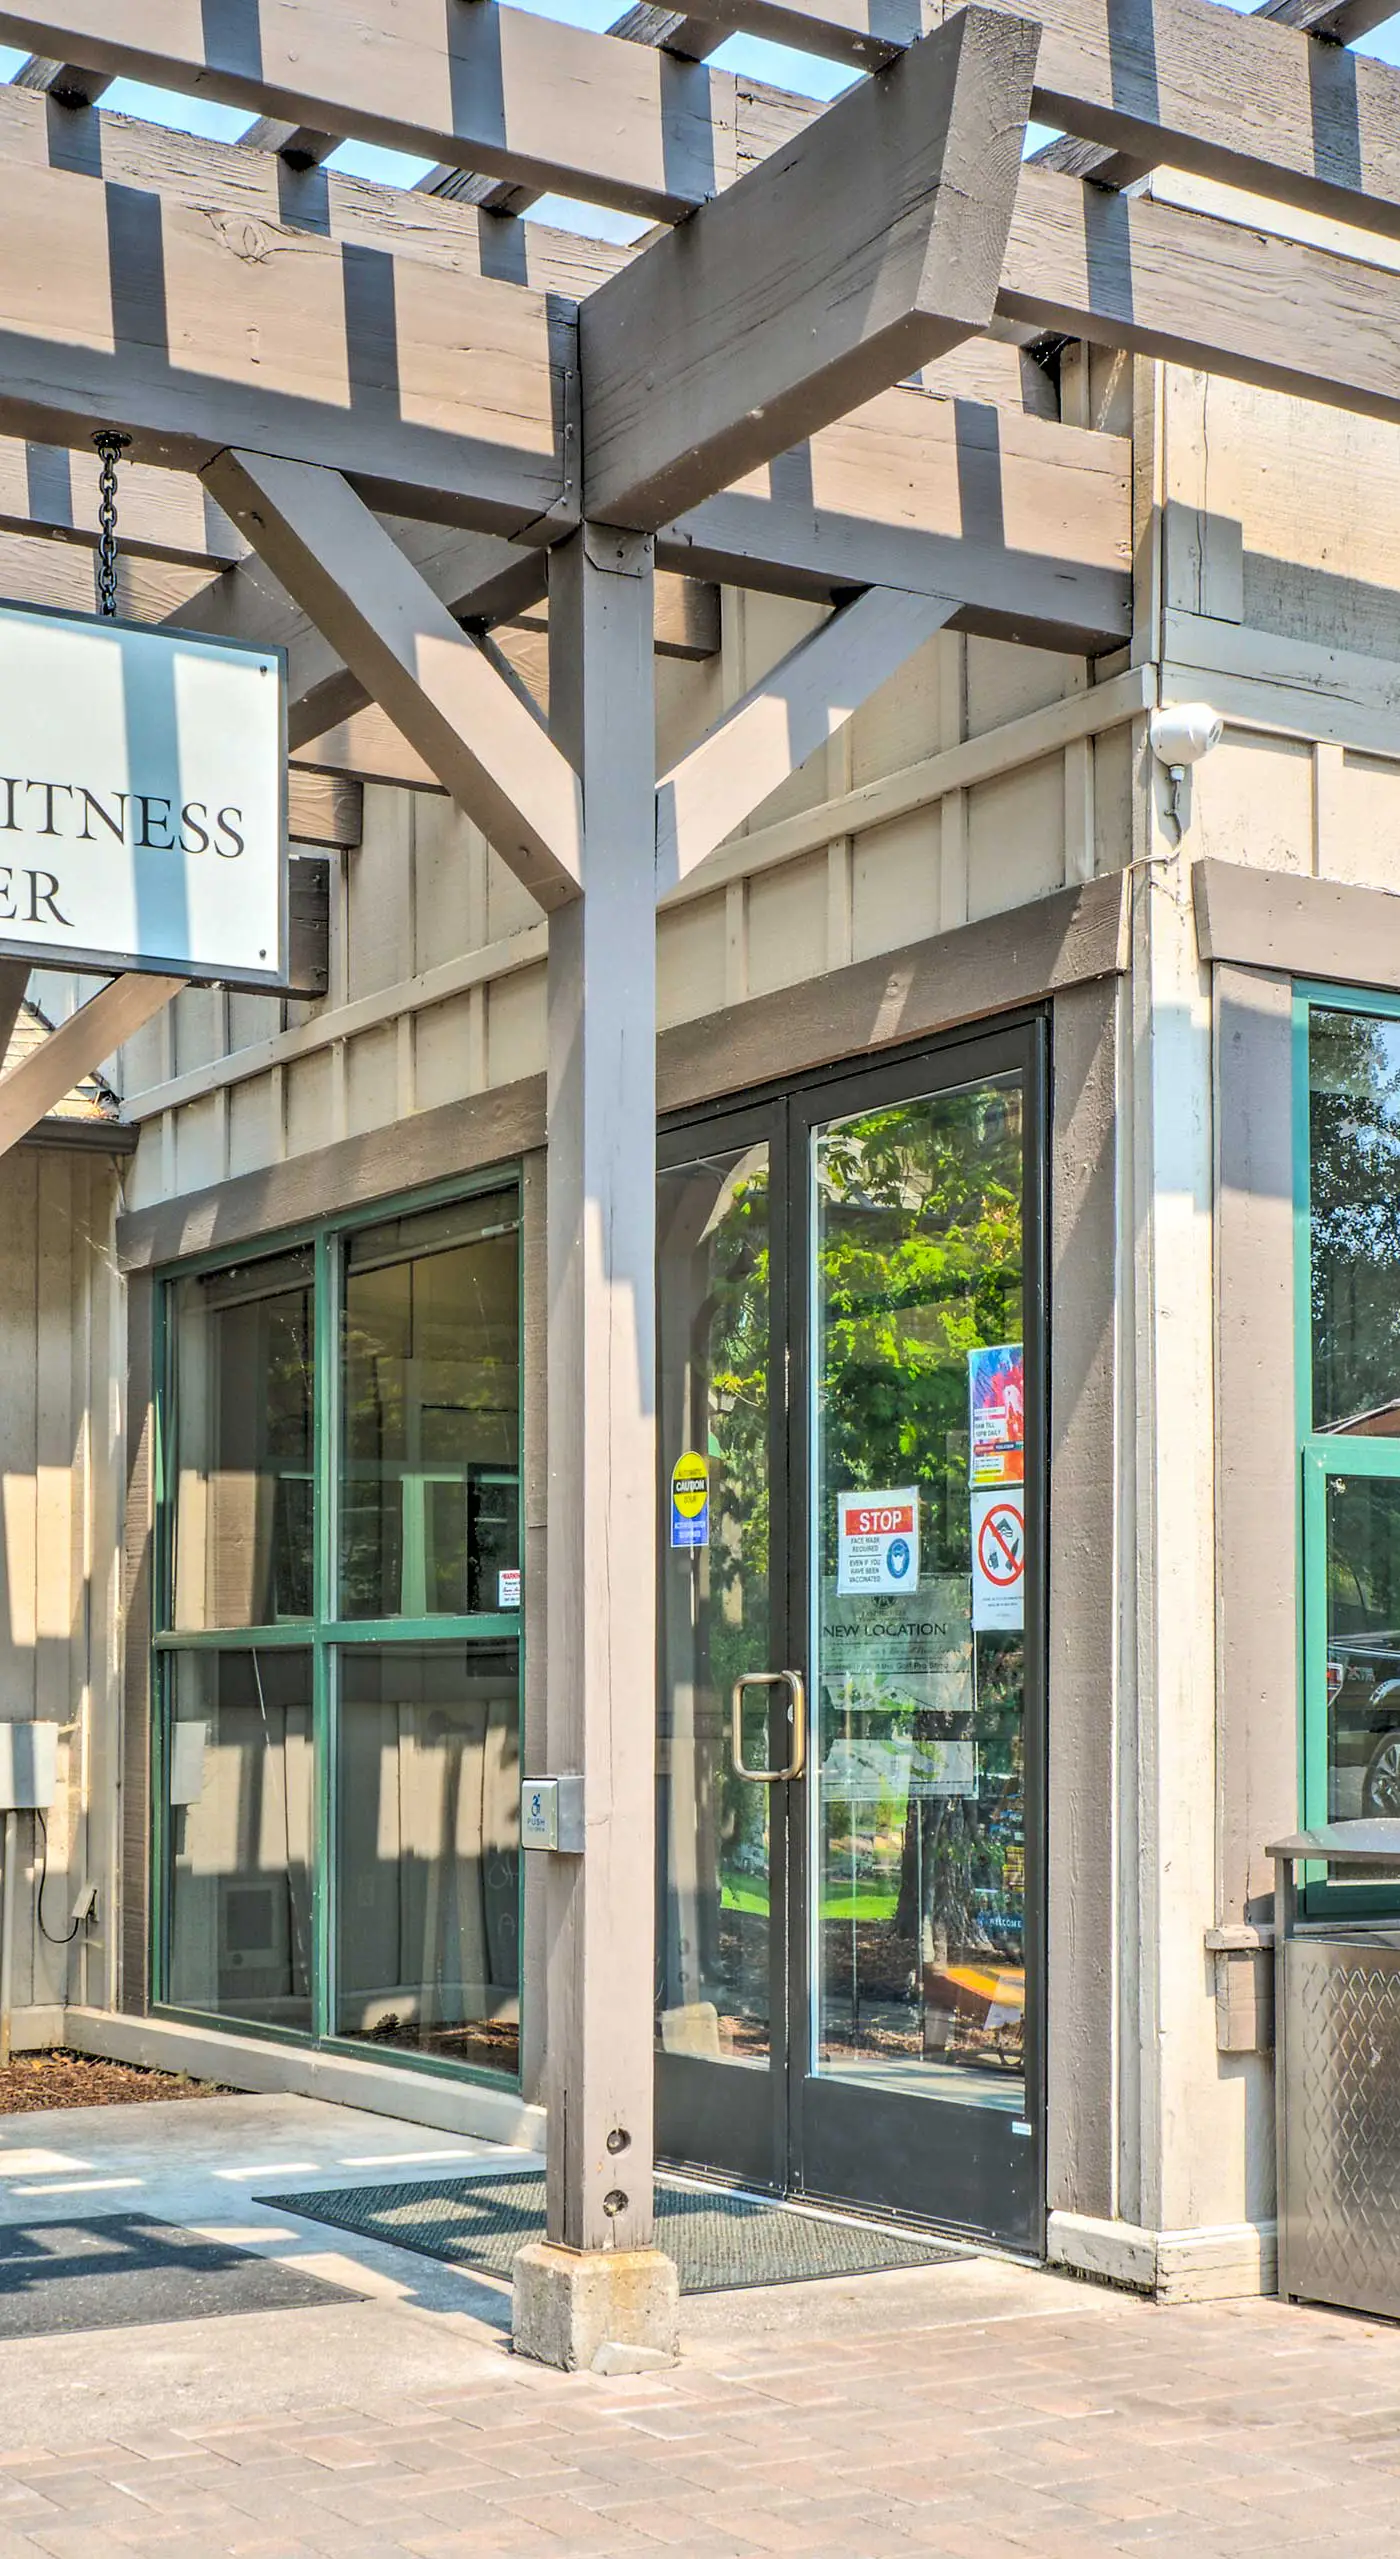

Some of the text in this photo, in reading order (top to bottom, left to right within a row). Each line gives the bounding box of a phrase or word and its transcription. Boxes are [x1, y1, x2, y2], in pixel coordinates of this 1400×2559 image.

[0, 777, 245, 858] ITNESS
[676, 1480, 704, 1492] CAUTION
[859, 1510, 902, 1532] STOP
[824, 1623, 946, 1637] NEW LOCATION
[528, 1817, 545, 1825] PUSH
[989, 1918, 1022, 1928] WELCOME
